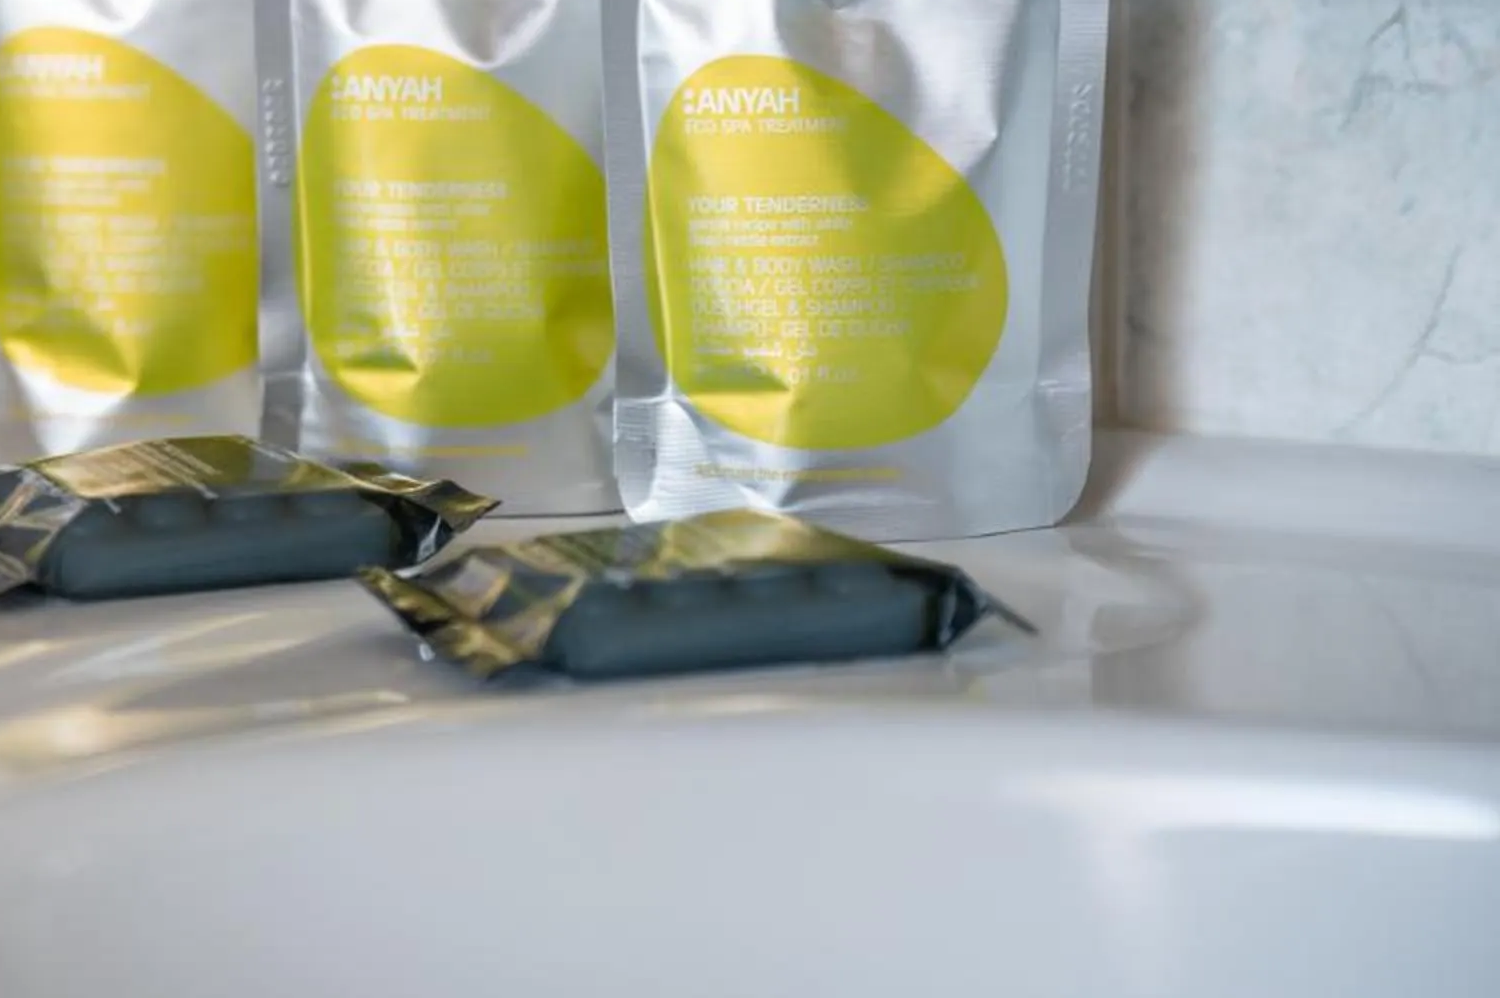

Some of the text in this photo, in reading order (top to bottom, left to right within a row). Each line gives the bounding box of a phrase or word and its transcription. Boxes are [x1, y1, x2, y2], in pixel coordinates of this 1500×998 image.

[682, 86, 799, 114] :ANYAH
[684, 118, 716, 136] ECO
[721, 118, 753, 135] SPA
[688, 195, 738, 213] YOUR
[752, 257, 804, 275] BODY
[808, 256, 861, 274] WASH
[774, 277, 807, 296] GEL
[780, 319, 812, 339] GEL
